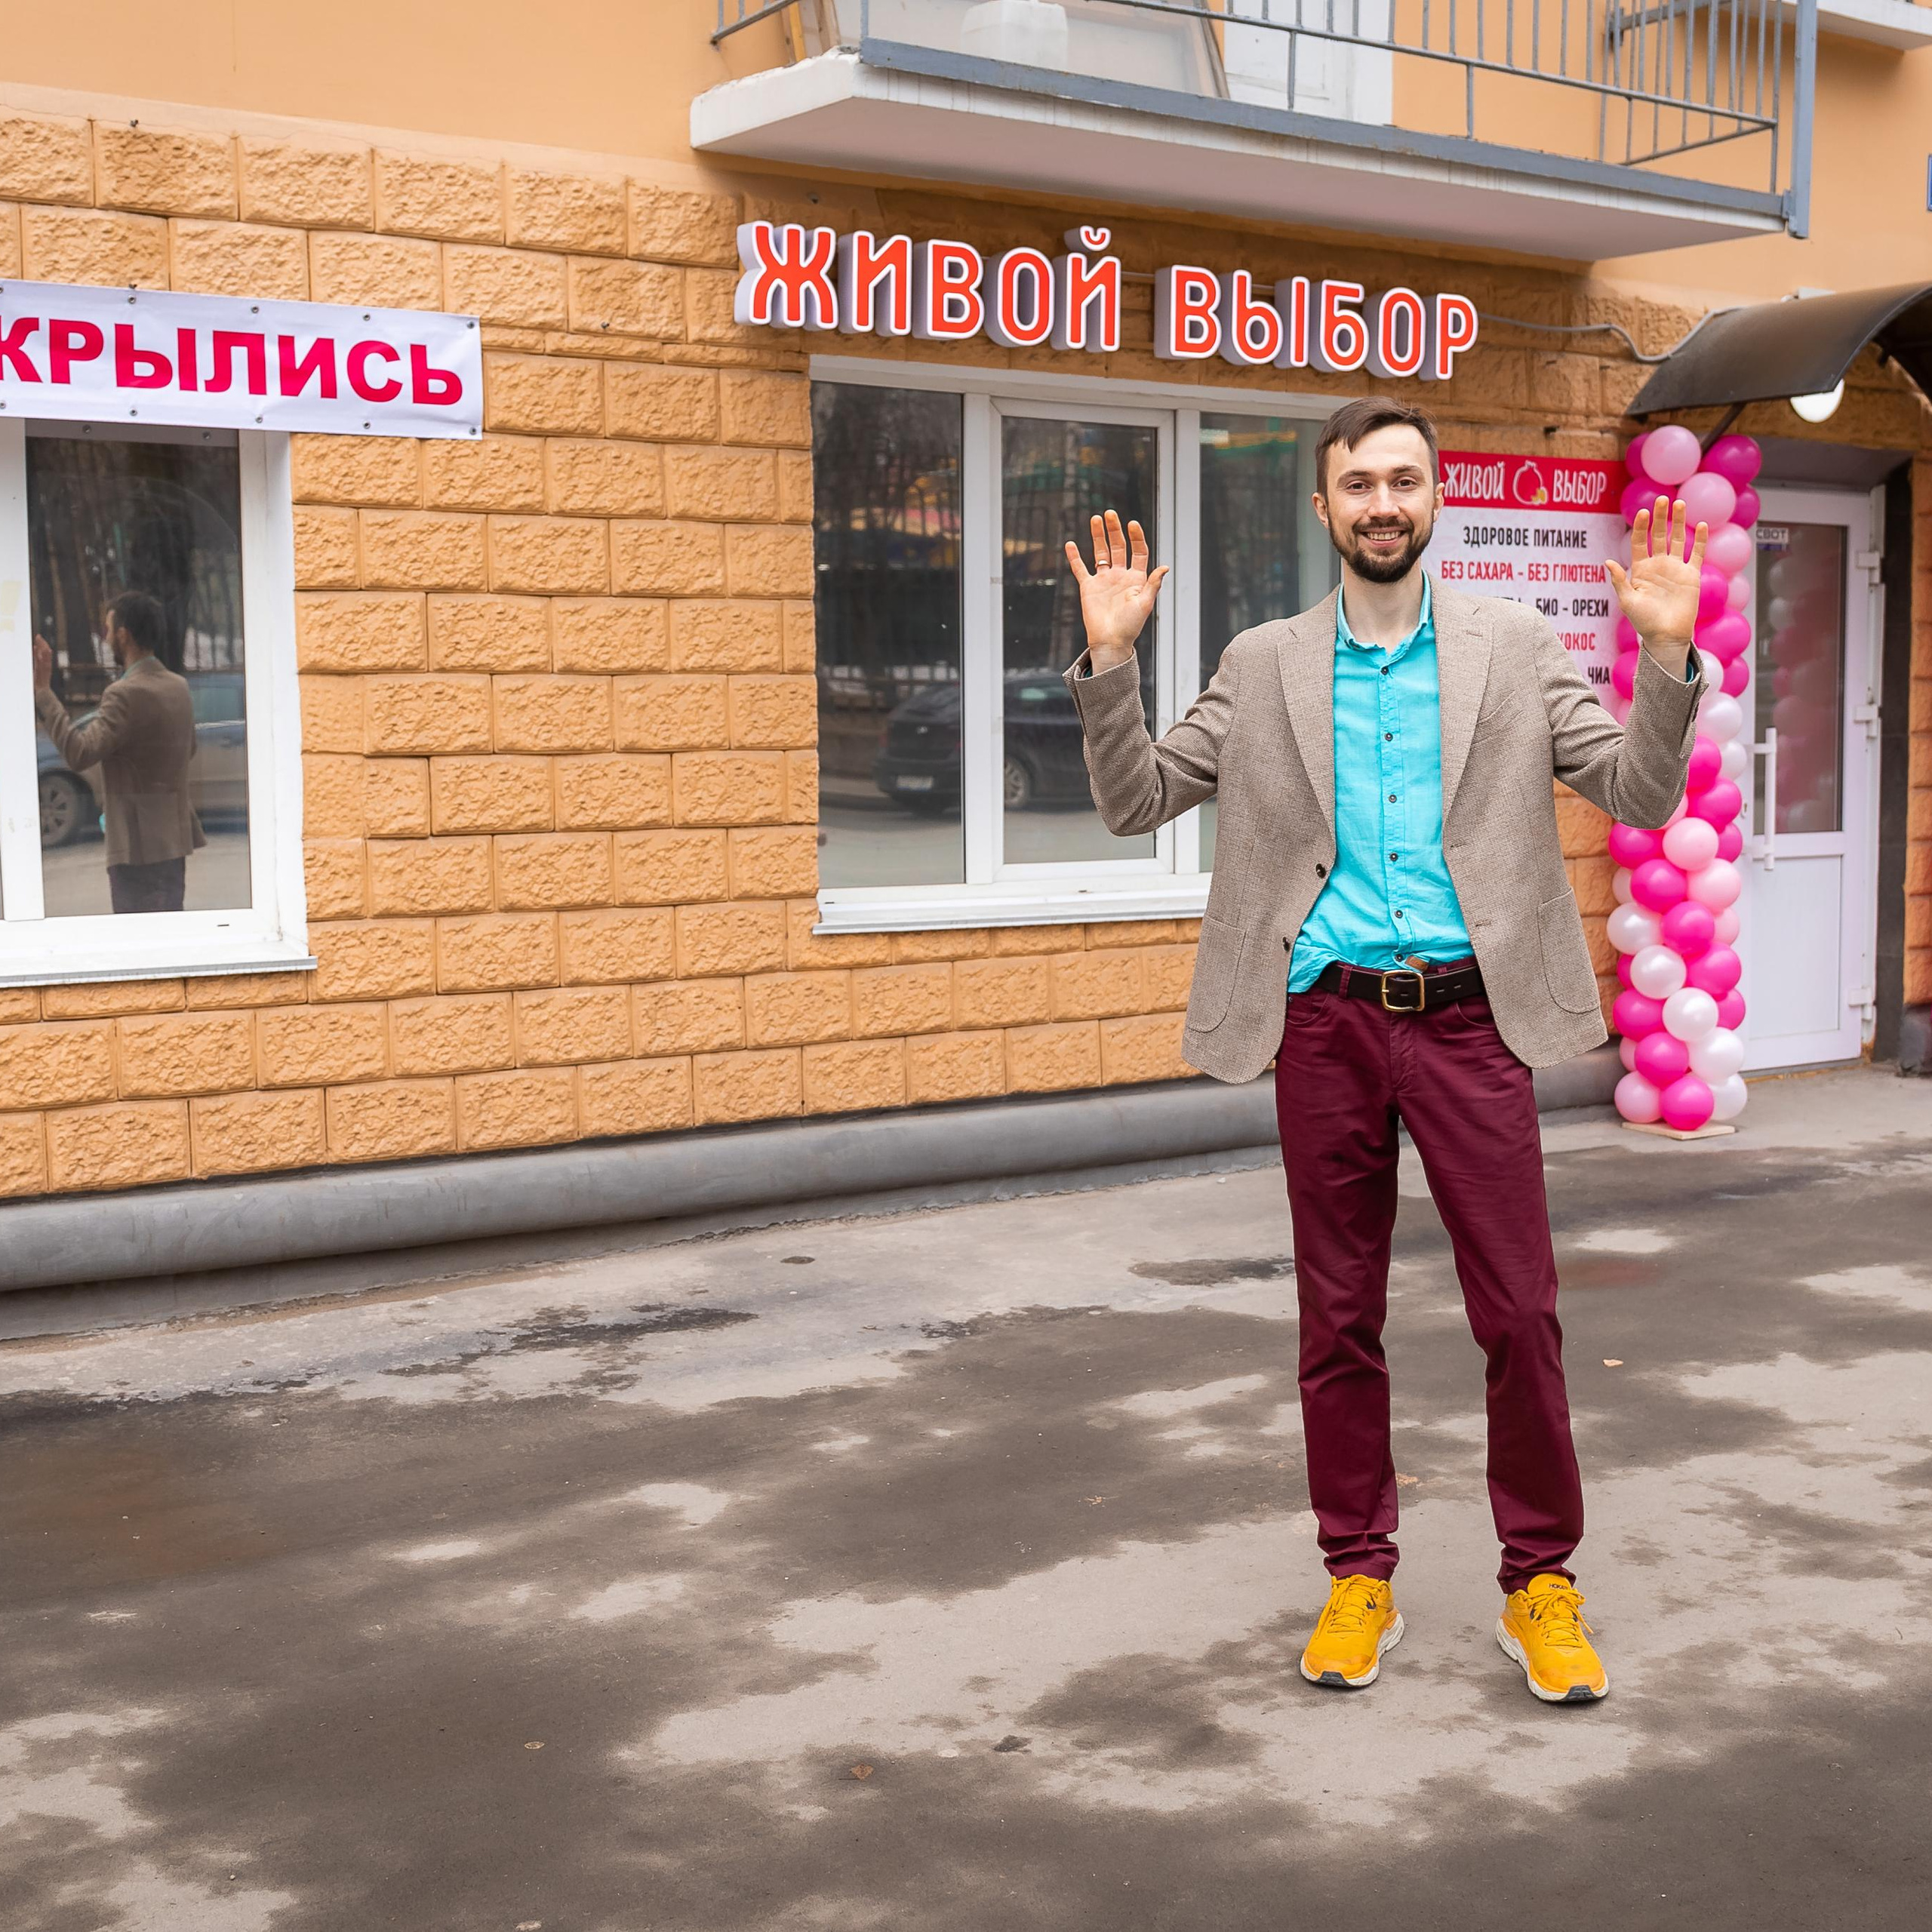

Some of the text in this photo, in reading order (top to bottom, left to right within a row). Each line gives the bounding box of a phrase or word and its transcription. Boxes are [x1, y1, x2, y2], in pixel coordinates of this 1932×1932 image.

[747, 220, 1478, 380] ЖИВОЙ ВЫБОР
[0, 315, 463, 406] КРЫЛИСЬ
[1444, 461, 1607, 505] ЖИВОЙ ВЫБОР
[1463, 526, 1587, 549] ЗДОРОВОЕ ПИТАНИЕ
[1441, 561, 1463, 580] БЕЗ
[1468, 561, 1514, 580] САХАРА
[1527, 563, 1549, 581] БЕЗ
[1552, 564, 1607, 583] ГЛЮТЕНА
[1536, 597, 1558, 617] БИО
[1572, 598, 1609, 617] ОРЕХИ
[1588, 666, 1611, 685] ЧИА
